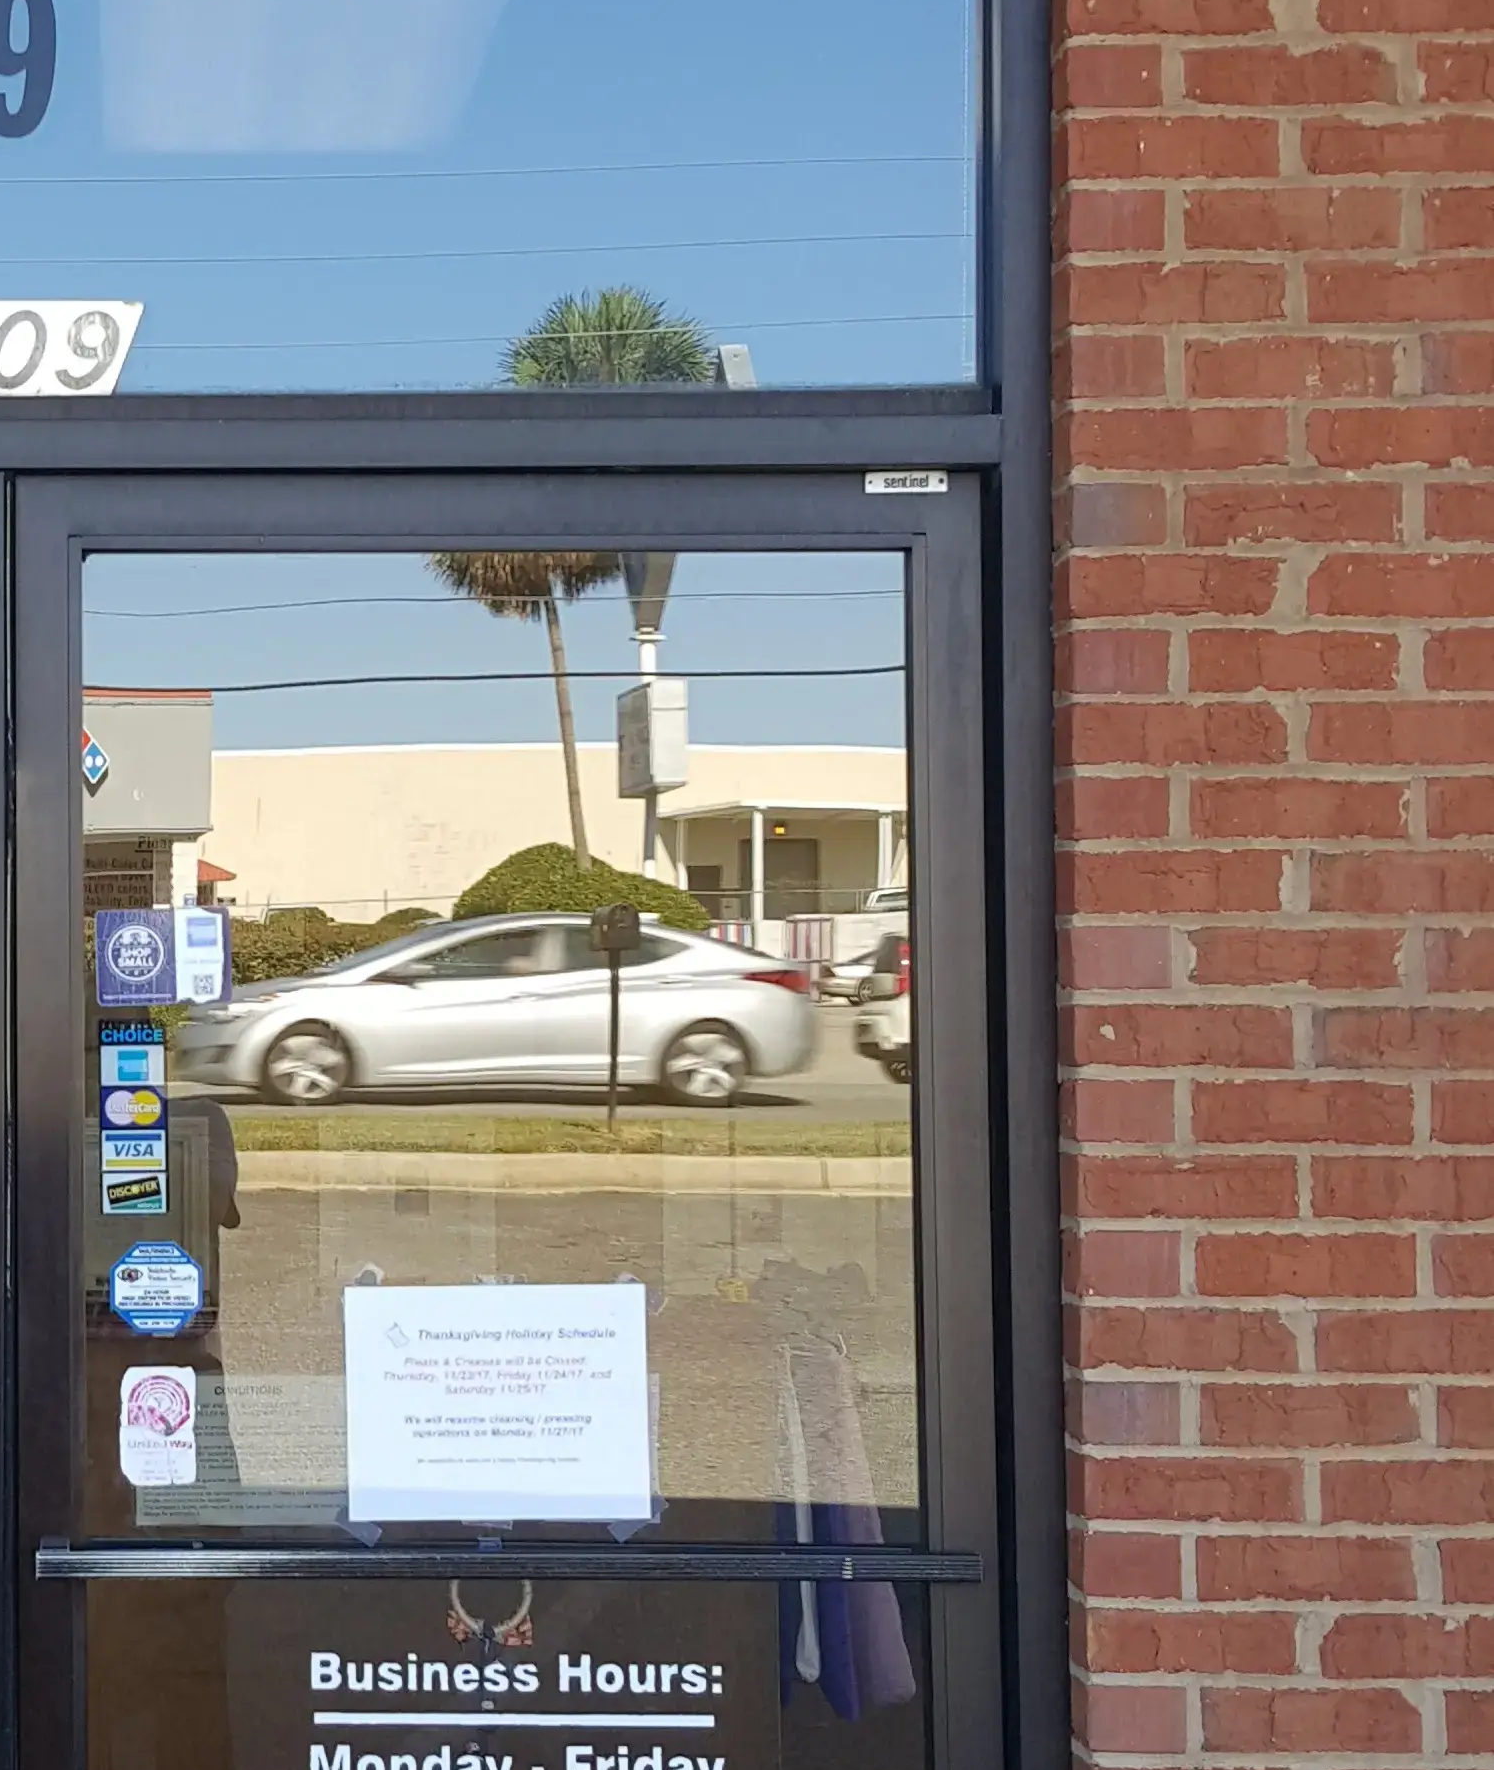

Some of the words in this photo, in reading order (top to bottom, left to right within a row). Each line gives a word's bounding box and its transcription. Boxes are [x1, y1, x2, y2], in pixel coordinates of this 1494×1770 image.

[883, 474, 929, 488] sentinel
[120, 947, 152, 957] SHOP
[117, 957, 154, 967] SMALL
[101, 1029, 164, 1042] CHOICE
[113, 1143, 154, 1157] VISA
[109, 1180, 158, 1200] DISCOVER
[417, 1328, 502, 1343] Thanksgiving
[505, 1328, 554, 1341] Holiday
[557, 1327, 616, 1339] Schedule
[543, 1415, 592, 1425] pressing
[169, 1440, 193, 1449] Way
[310, 1652, 540, 1694] Business
[557, 1653, 723, 1694] Hours:
